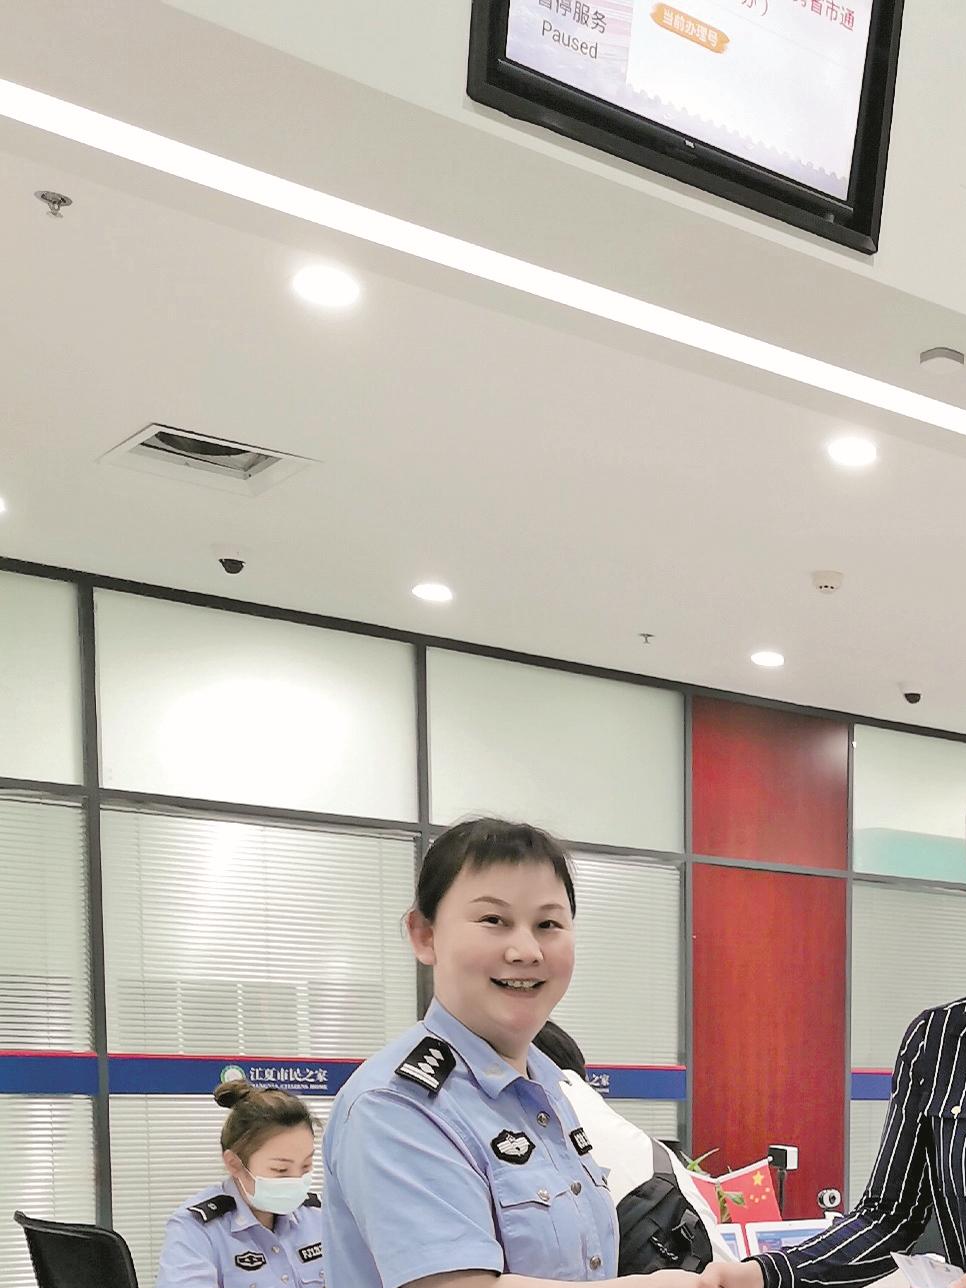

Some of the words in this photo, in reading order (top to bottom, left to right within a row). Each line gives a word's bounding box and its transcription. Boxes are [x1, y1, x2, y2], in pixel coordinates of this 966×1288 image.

[541, 19, 599, 60] Paused
[249, 1067, 328, 1082] 江夏市民之家
